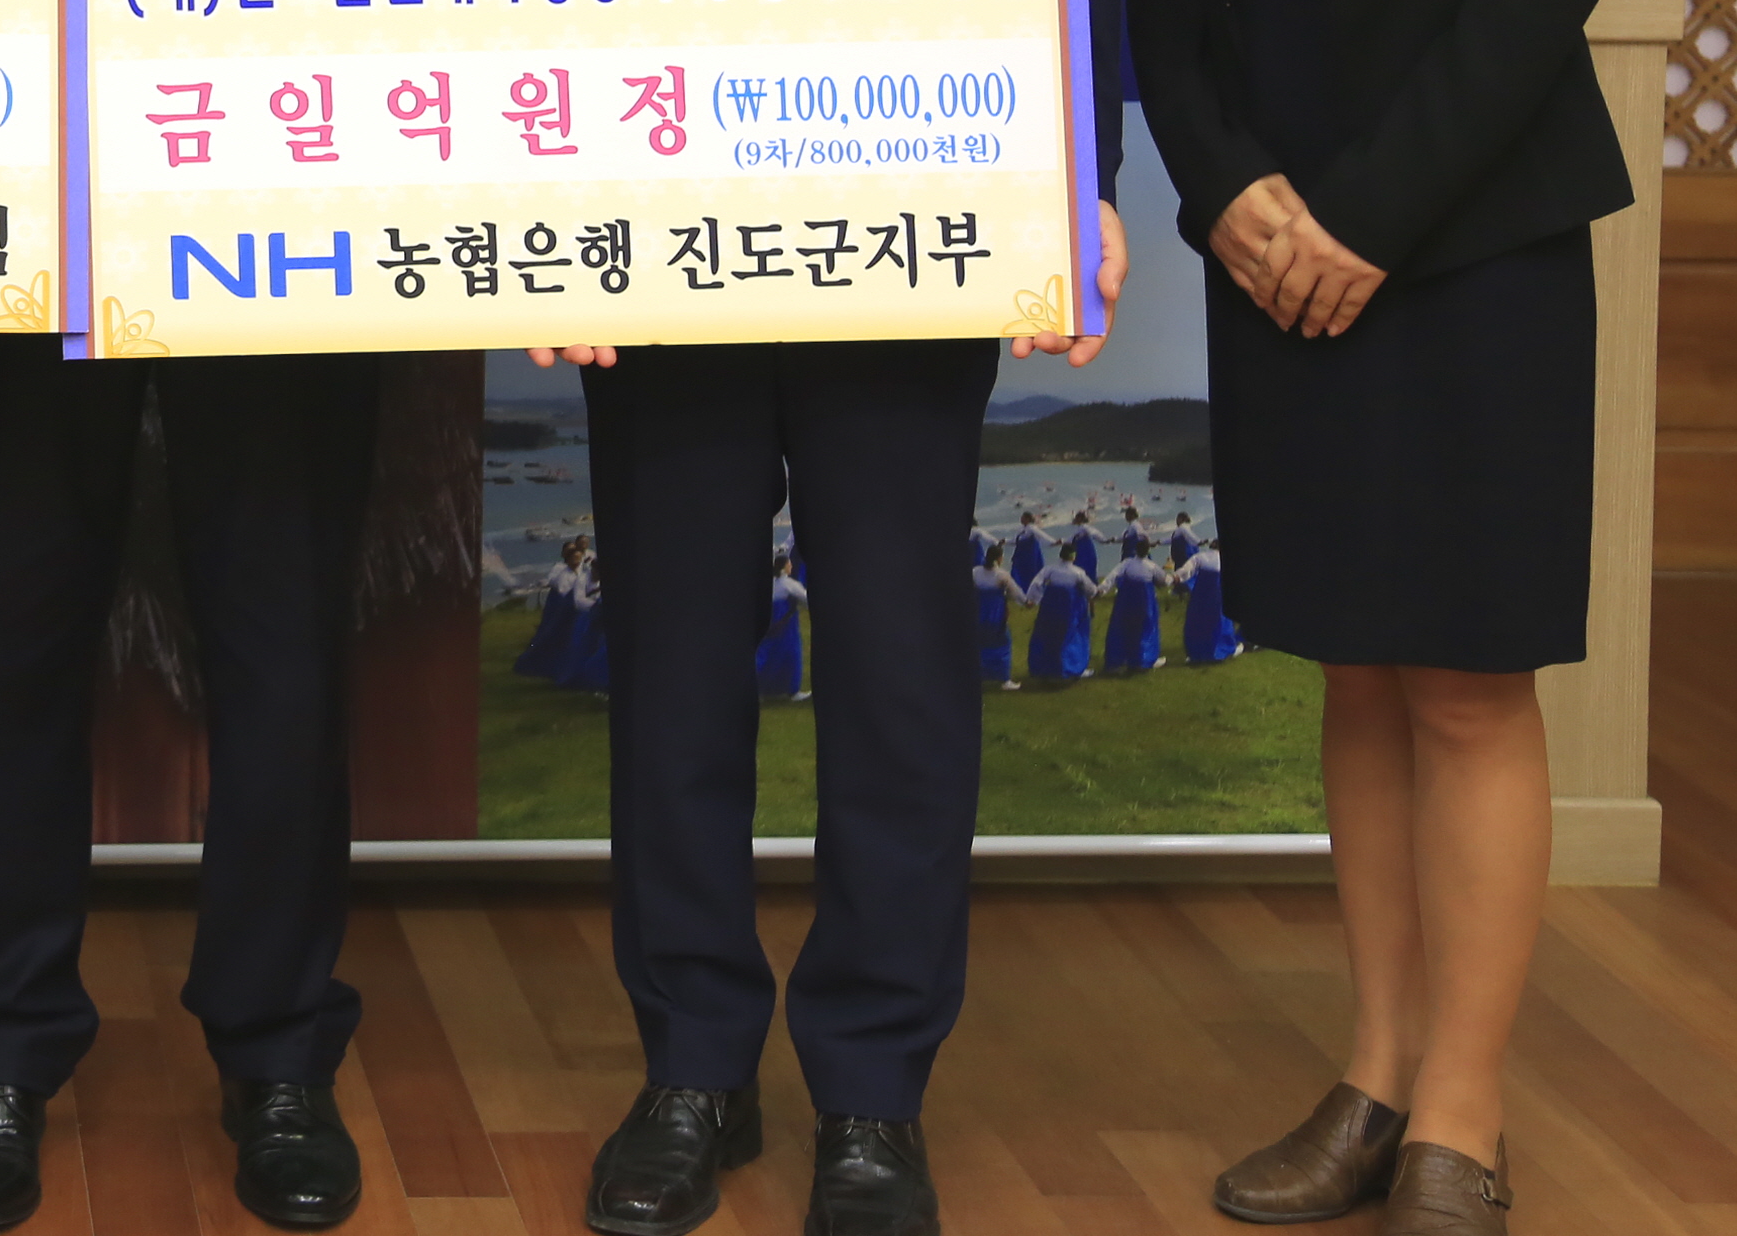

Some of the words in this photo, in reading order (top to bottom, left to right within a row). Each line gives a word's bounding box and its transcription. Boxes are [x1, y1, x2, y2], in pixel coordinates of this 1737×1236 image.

[734, 133, 1001, 169] (9차/800,000천원)
[170, 230, 353, 301] NH
[376, 218, 632, 299] 농협은행
[666, 212, 992, 290] 진도군지부
